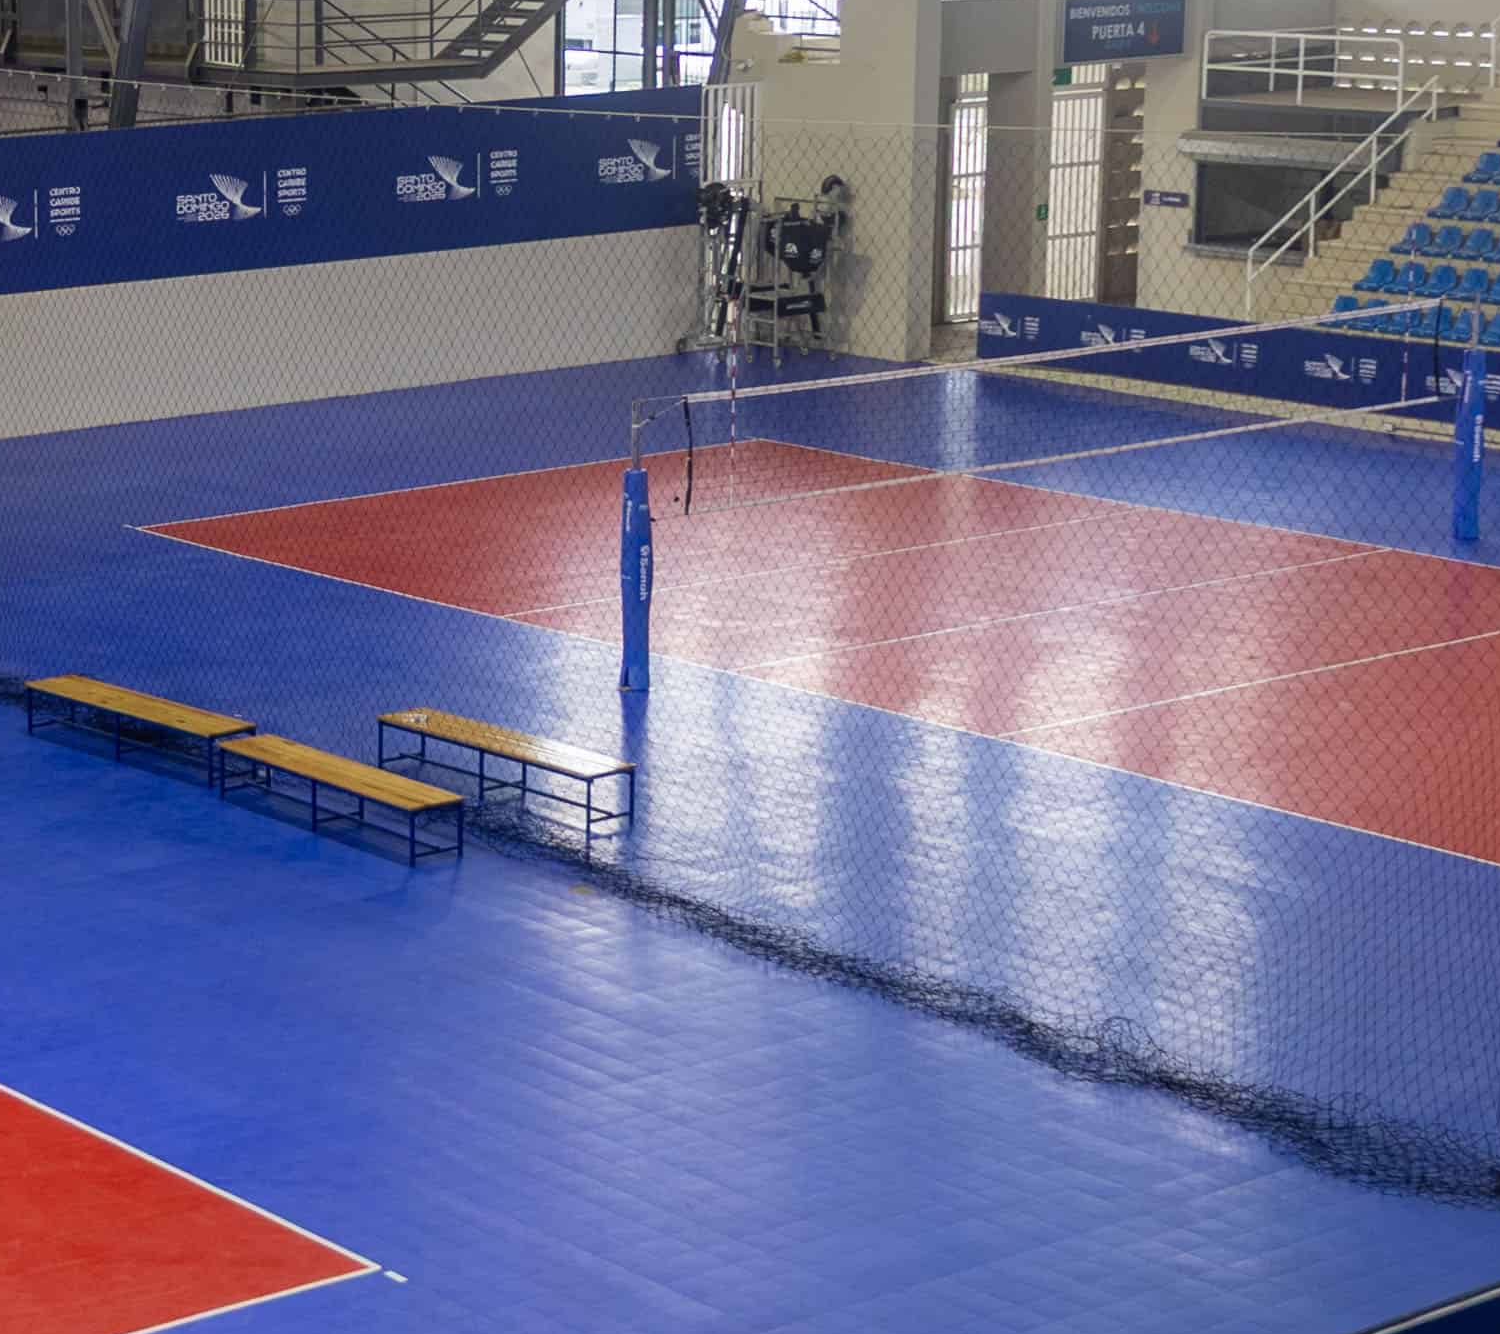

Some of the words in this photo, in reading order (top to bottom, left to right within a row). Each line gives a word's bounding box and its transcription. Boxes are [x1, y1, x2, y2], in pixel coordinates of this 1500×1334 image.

[1070, 3, 1130, 19] BIENVENIDOS
[1092, 23, 1134, 41] PUERTA
[1136, 21, 1145, 37] 4
[49, 186, 81, 196] CENTRO
[49, 196, 81, 207] CARIBE
[50, 207, 81, 217] SPORTS
[639, 556, 649, 602] Senoh
